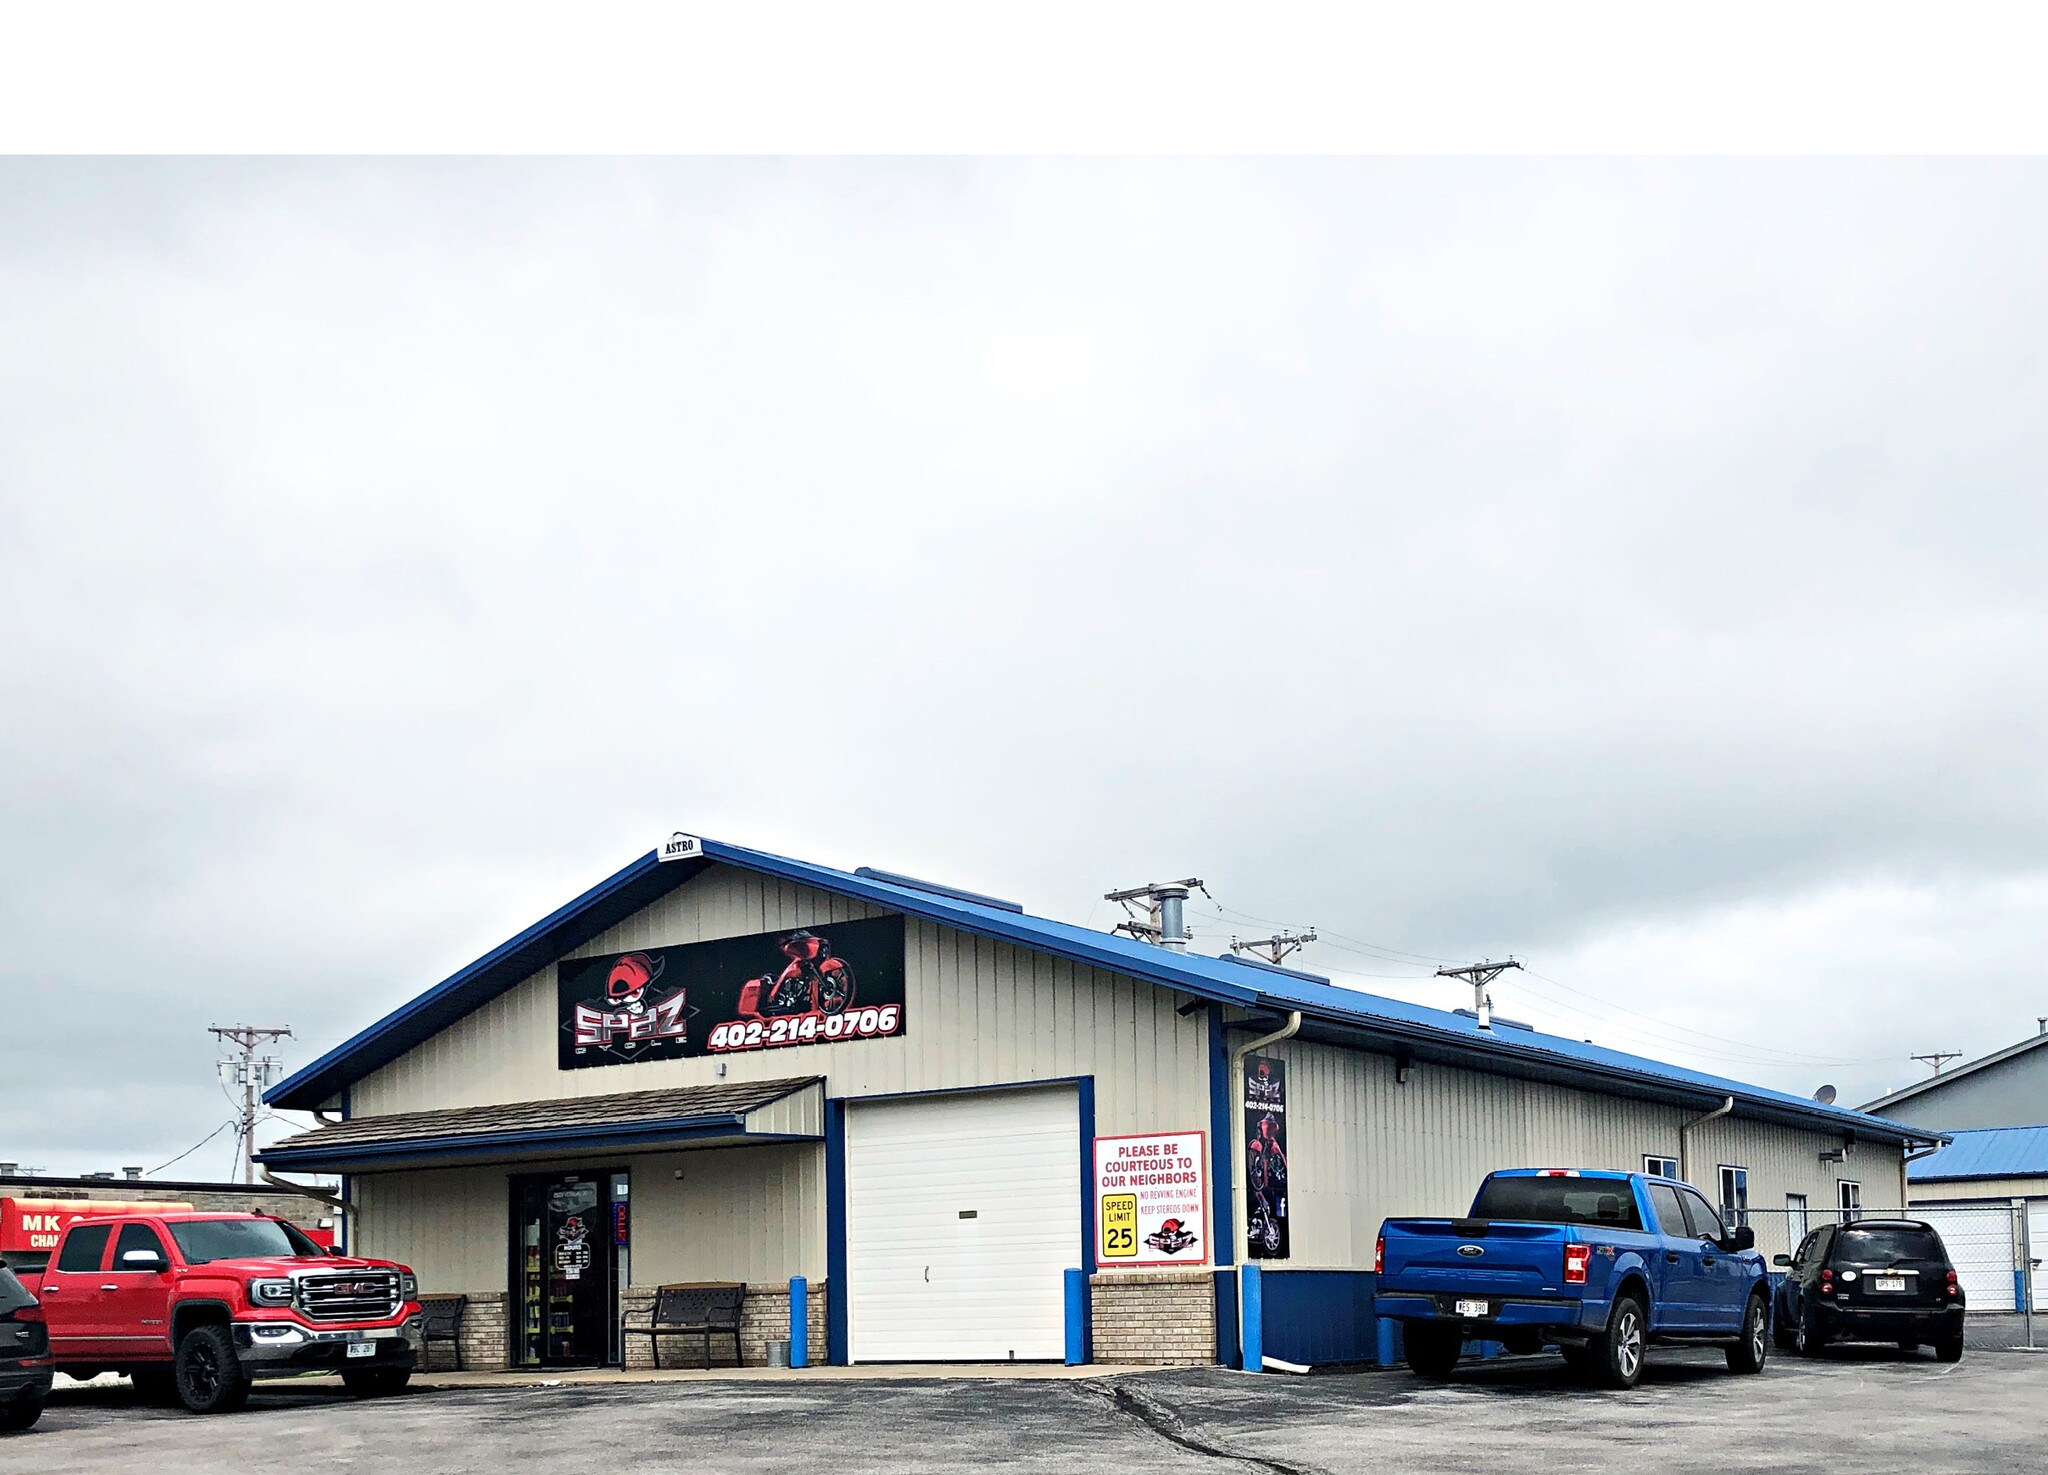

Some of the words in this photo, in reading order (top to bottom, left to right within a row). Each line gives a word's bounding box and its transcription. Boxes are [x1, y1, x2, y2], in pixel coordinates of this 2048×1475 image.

[665, 839, 694, 854] ASTRO
[710, 1006, 898, 1049] 402-214-0706
[1245, 1100, 1284, 1113] 402-214-0706
[1118, 1145, 1160, 1158] PLEASE
[1163, 1143, 1178, 1155] BE
[1105, 1158, 1174, 1173] COURTEOUS
[1177, 1157, 1193, 1169] TO
[1102, 1175, 1126, 1187] OUR
[1130, 1171, 1197, 1186] NEIGHBORS
[1140, 1190, 1149, 1200] NO
[1175, 1188, 1197, 1199] ENGINE
[1106, 1200, 1134, 1211] SPEED
[1140, 1205, 1155, 1215] KEEP
[1181, 1203, 1199, 1213] DOWN
[22, 1215, 62, 1232] MK
[1108, 1212, 1131, 1222] LIMIT
[1107, 1228, 1133, 1249] 25
[333, 1282, 376, 1295] GMC
